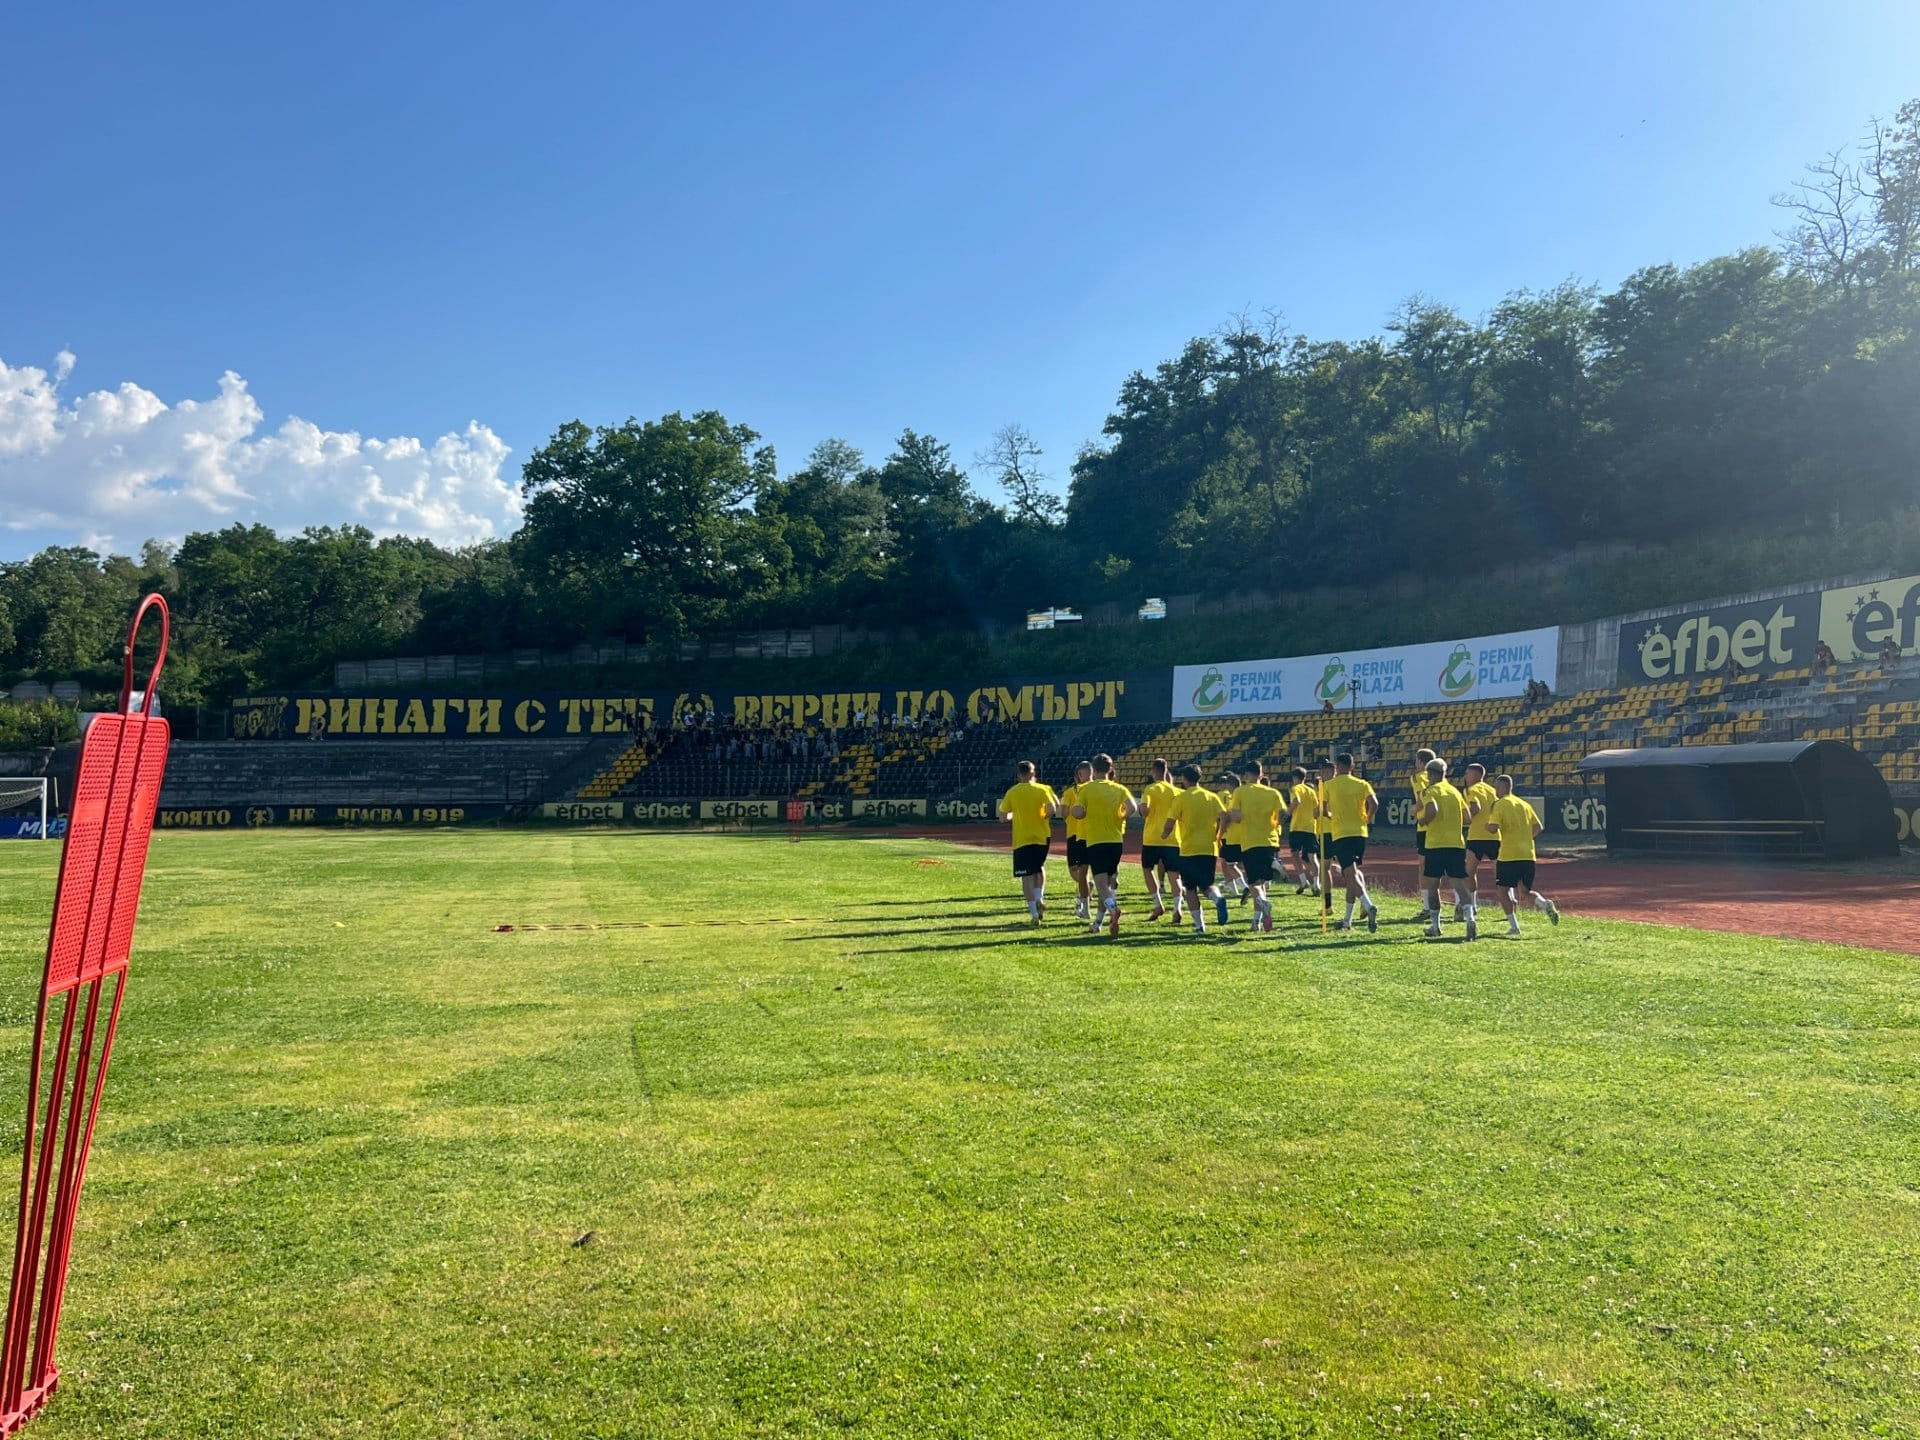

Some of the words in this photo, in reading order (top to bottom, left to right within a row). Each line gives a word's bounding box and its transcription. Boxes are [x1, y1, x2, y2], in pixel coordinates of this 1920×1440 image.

[1640, 603, 1796, 678] efbet
[1479, 645, 1534, 665] PERNIK
[1353, 659, 1404, 678] PERNIK
[1478, 662, 1534, 685] PLAZA
[1230, 670, 1282, 687] PERNIK
[1230, 686, 1282, 703] PLAZA
[295, 698, 502, 733] ВИНАГИ
[967, 680, 1124, 723] СМЪРТ
[161, 810, 231, 826] КОЯТО
[413, 808, 465, 821] 1919
[556, 803, 613, 819] efbet
[633, 802, 692, 818] efbet
[710, 801, 768, 817] efbet
[863, 801, 917, 817] efbet
[935, 800, 988, 818] efbet
